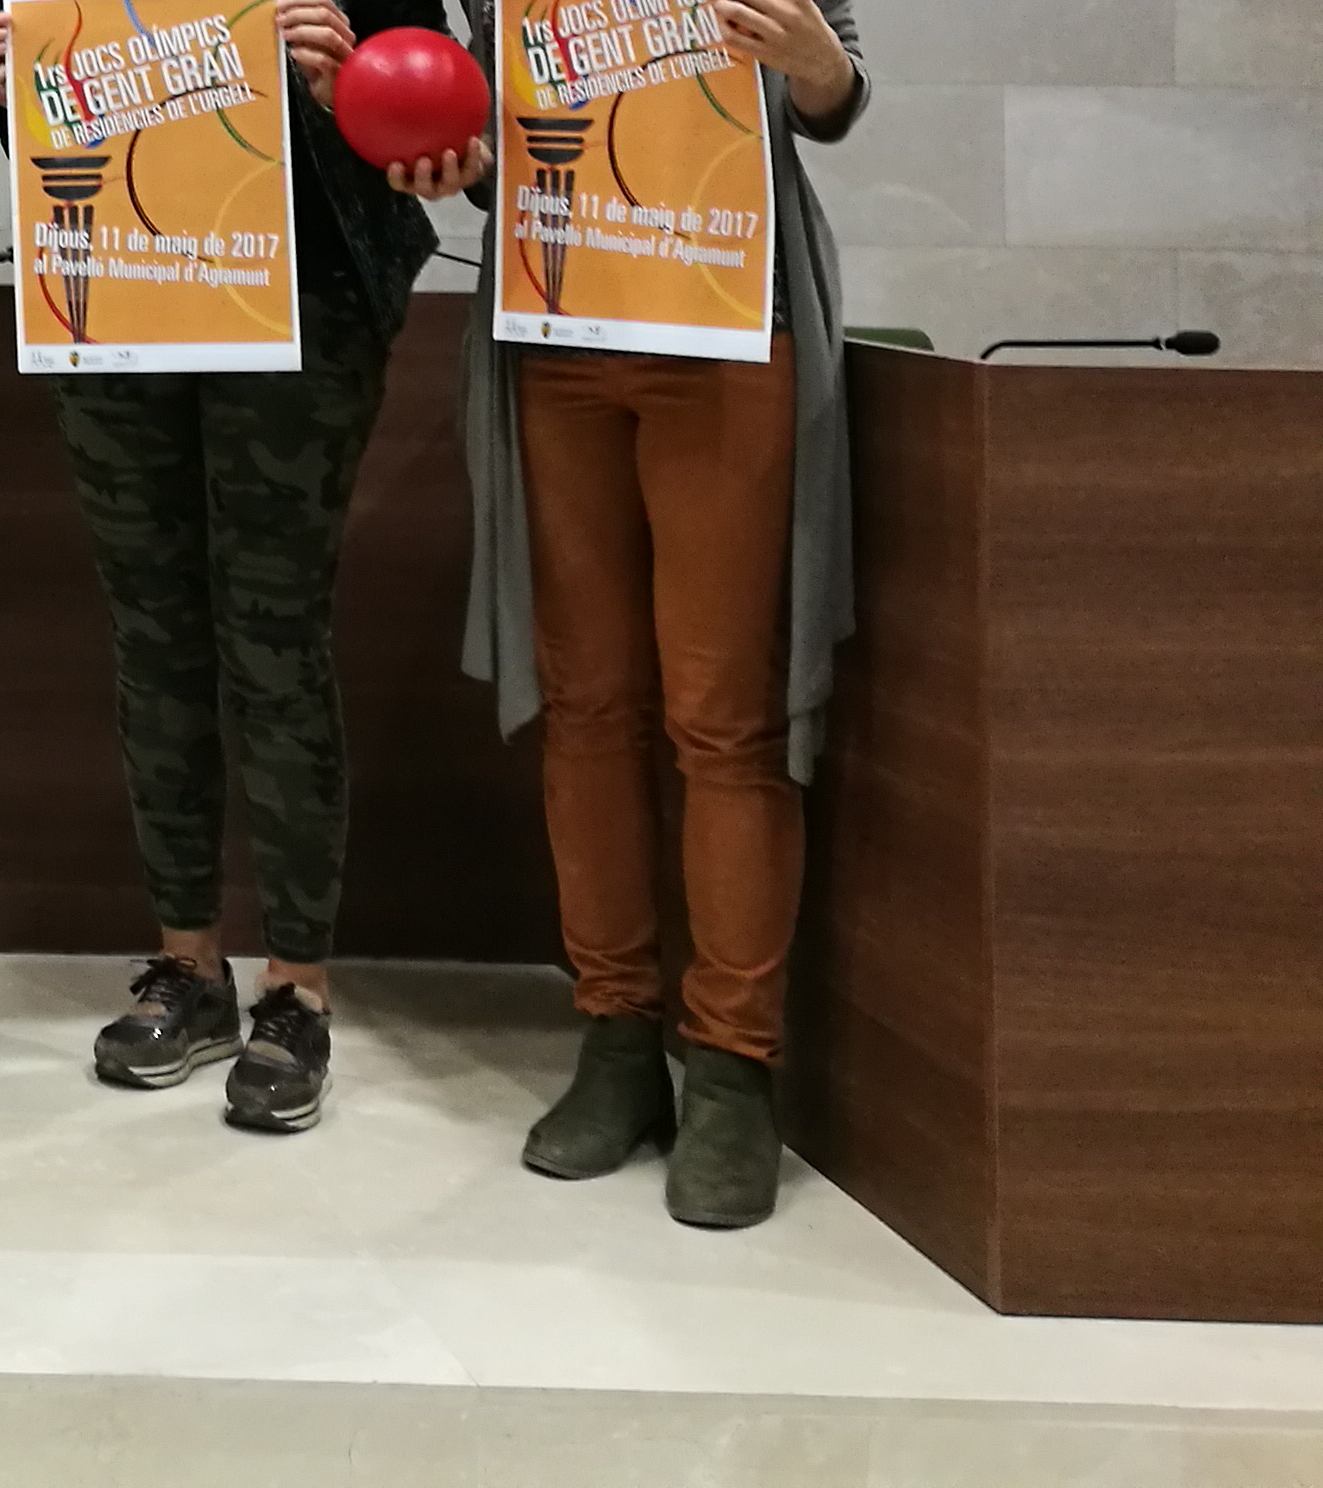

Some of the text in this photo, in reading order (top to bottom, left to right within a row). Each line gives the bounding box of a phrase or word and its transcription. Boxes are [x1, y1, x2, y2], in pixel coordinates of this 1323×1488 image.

[521, 16, 554, 45] 1rs
[557, 1, 607, 37] JOCS
[527, 5, 722, 85] DE GENT GRAN
[33, 16, 231, 89] 1rs JOCS OLÍMPICS
[40, 43, 244, 126] DE GENT GRAN
[165, 96, 188, 121] DE
[100, 226, 119, 250] 11
[128, 228, 148, 252] de
[155, 230, 197, 260] maig
[204, 232, 224, 256] de
[231, 232, 278, 259] 2017
[707, 208, 757, 239] 2017
